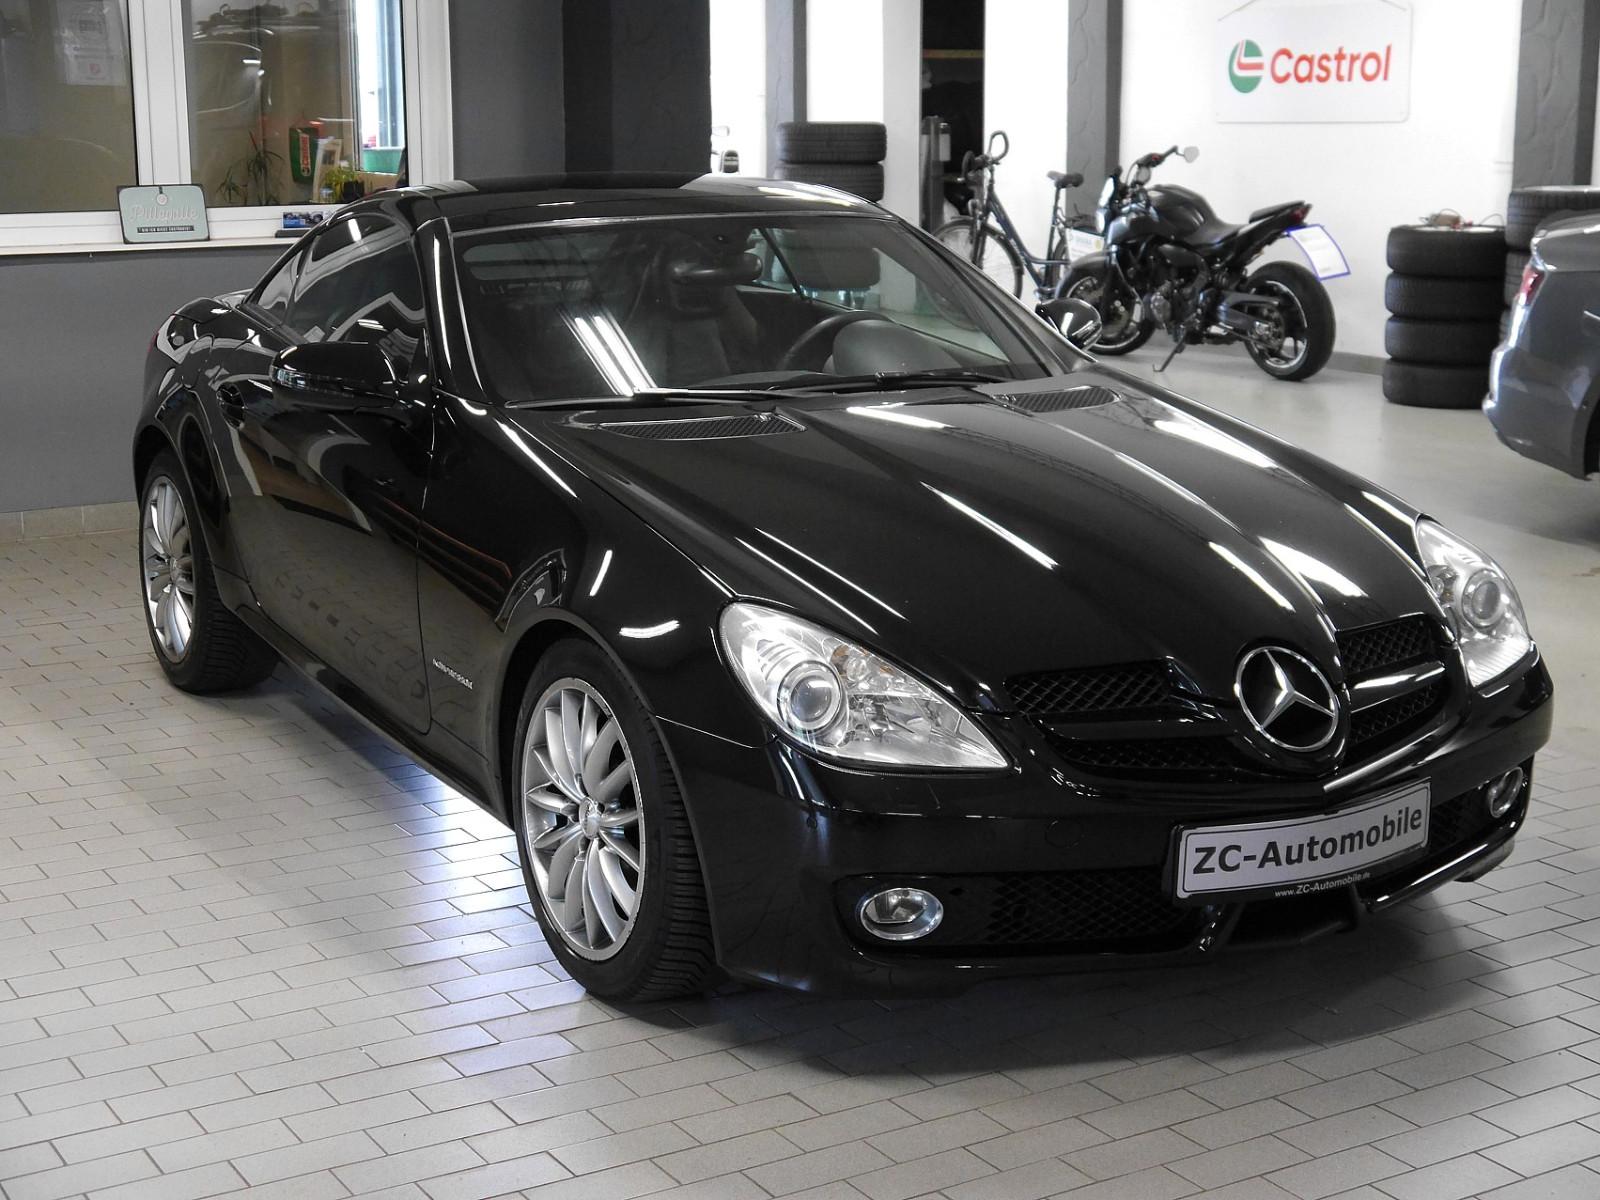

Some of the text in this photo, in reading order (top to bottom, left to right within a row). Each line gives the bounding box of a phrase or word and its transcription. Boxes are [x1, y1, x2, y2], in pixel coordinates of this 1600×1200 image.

[1270, 43, 1392, 84] Castrol
[1192, 806, 1423, 875] ZC-Automobile
[1274, 871, 1371, 898] www.ZC-Automobile.de
